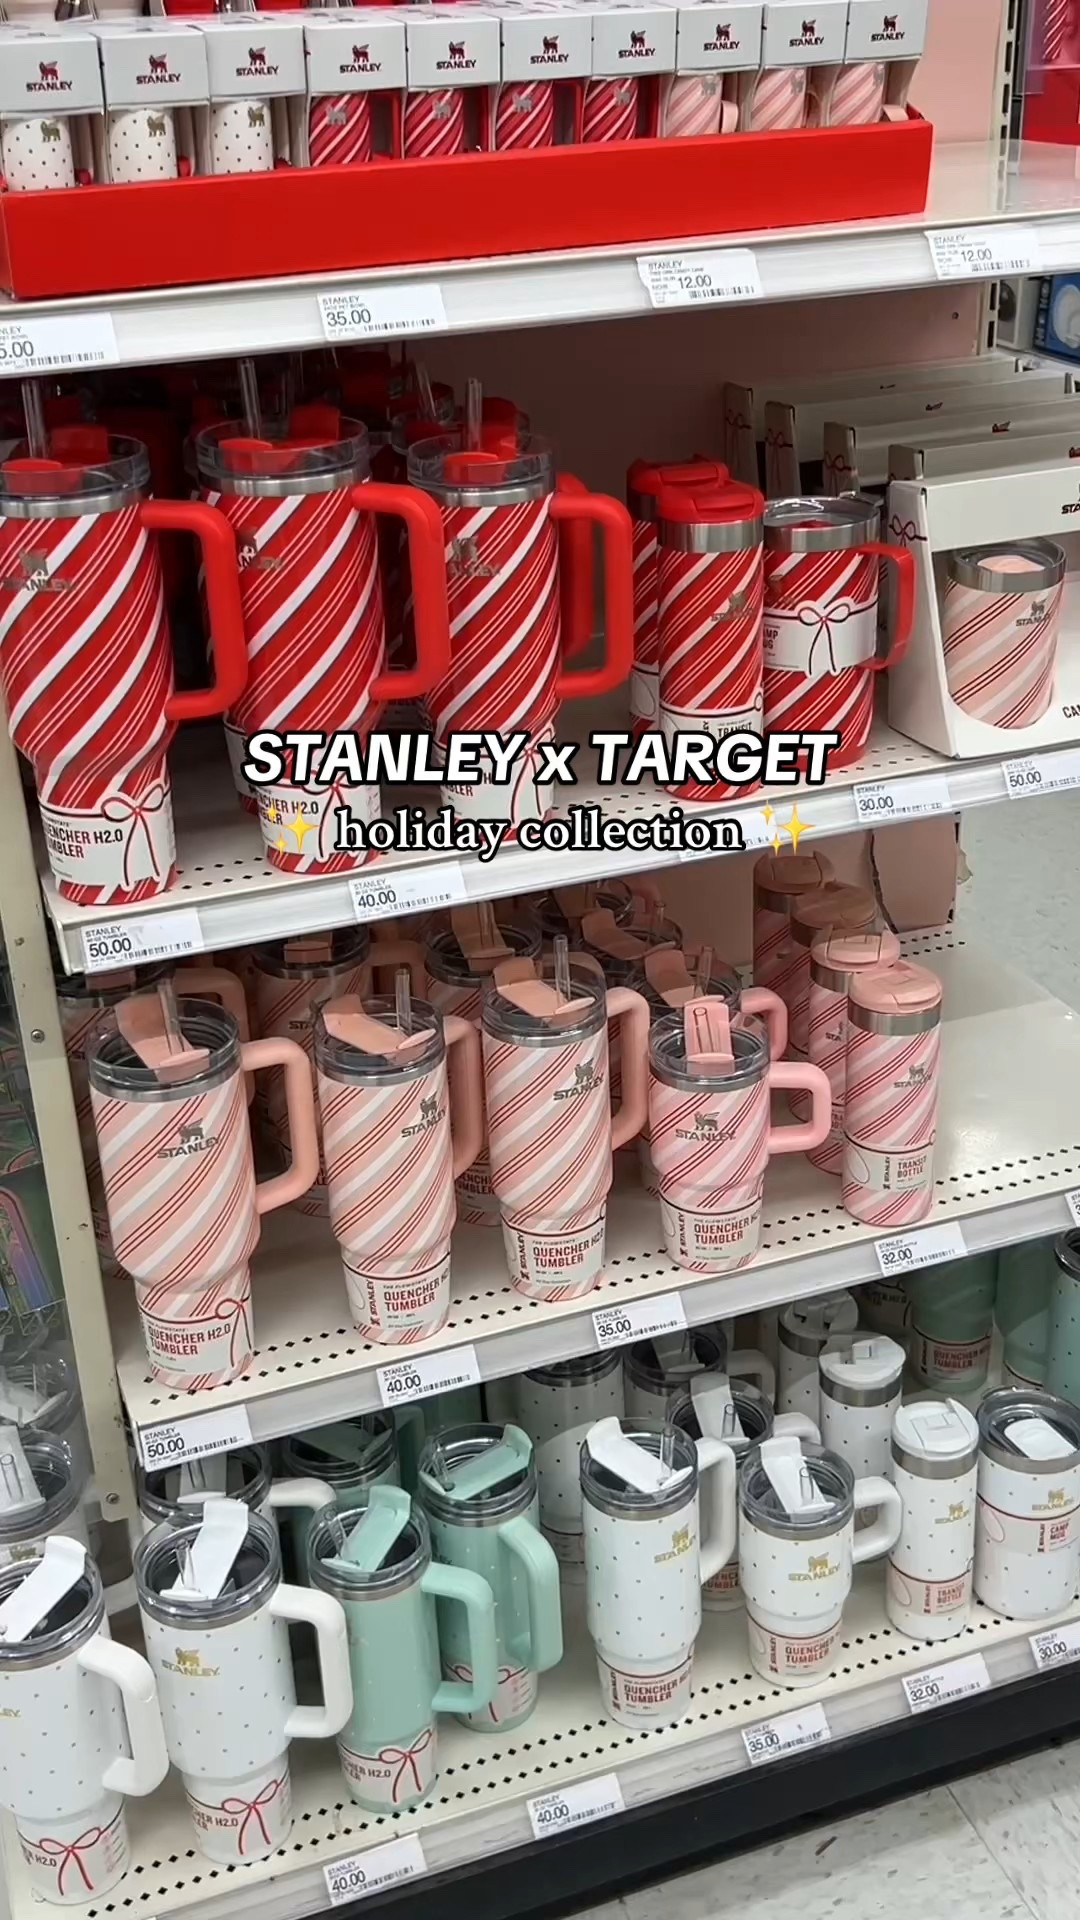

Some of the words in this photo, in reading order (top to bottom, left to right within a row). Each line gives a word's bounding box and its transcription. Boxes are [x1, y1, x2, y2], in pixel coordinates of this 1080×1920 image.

[789, 36, 824, 47] STANLEY
[870, 31, 905, 42] STANLEY
[618, 48, 656, 58] STANLEY
[703, 41, 740, 51] STANLEY
[436, 59, 477, 71] STANLEY
[530, 53, 569, 65] STANLEY
[236, 65, 279, 77] STANLEY
[339, 63, 382, 74] STANLEY
[26, 80, 73, 92] STANLEY
[136, 73, 181, 85] STANLEY
[961, 248, 992, 262] 12.00
[678, 275, 712, 289] 12.00
[322, 295, 360, 305] STANLEY
[326, 309, 371, 327] 35.00
[1009, 771, 1042, 788] 50.00
[856, 784, 885, 794] STANLEY
[859, 795, 894, 812] 30.00
[93, 828, 123, 844] H2.0
[354, 878, 386, 890] STANLEY
[358, 889, 397, 908] 40.00
[86, 925, 121, 938] STANLEY
[89, 937, 131, 957] 50.00
[553, 1073, 604, 1101] STANLEY
[401, 1108, 446, 1138] STANLEY
[675, 1128, 736, 1143] STANLEY
[157, 1136, 220, 1159] STANLEY
[897, 1155, 926, 1170] TRANSIT
[897, 1166, 923, 1178] BOTTLE
[694, 1216, 749, 1234] QUENCHER
[694, 1230, 743, 1245] TUMBLER
[878, 1239, 903, 1250] STANLEY
[533, 1240, 589, 1257] QUENCHER
[881, 1247, 912, 1265] 32.00
[534, 1253, 583, 1269] TUMBLER
[384, 1277, 440, 1301] QUENCHER
[384, 1291, 435, 1312] TUMBLER
[595, 1310, 622, 1321] STANLEY
[147, 1325, 205, 1344] QUENCHER
[208, 1323, 231, 1341] H2.0
[598, 1319, 631, 1337] 35.00
[149, 1336, 198, 1355] TUMBLER
[383, 1363, 413, 1377] STANLEY
[387, 1374, 421, 1393] 40.00
[144, 1427, 176, 1440] STANLEY
[147, 1437, 184, 1458] 50.00
[1050, 1522, 1069, 1534] CAMP
[788, 1563, 840, 1581] STANLEY
[785, 1636, 834, 1655] QUENCHER
[1039, 1641, 1067, 1660] 30.00
[786, 1647, 830, 1664] TUMBLER
[161, 1659, 221, 1677] STANLEY
[624, 1679, 678, 1695] QUENCHER
[910, 1682, 940, 1702] 32.00
[625, 1691, 672, 1703] TUMBLER
[749, 1733, 779, 1752] 35.00
[367, 1769, 391, 1778] H2.0
[533, 1794, 560, 1807] STANLEY
[537, 1804, 569, 1823] 40.00
[215, 1817, 239, 1827] H2.0
[35, 1854, 57, 1867] H2.0
[328, 1861, 356, 1876] STANLEY
[332, 1870, 366, 1890] 40.00
